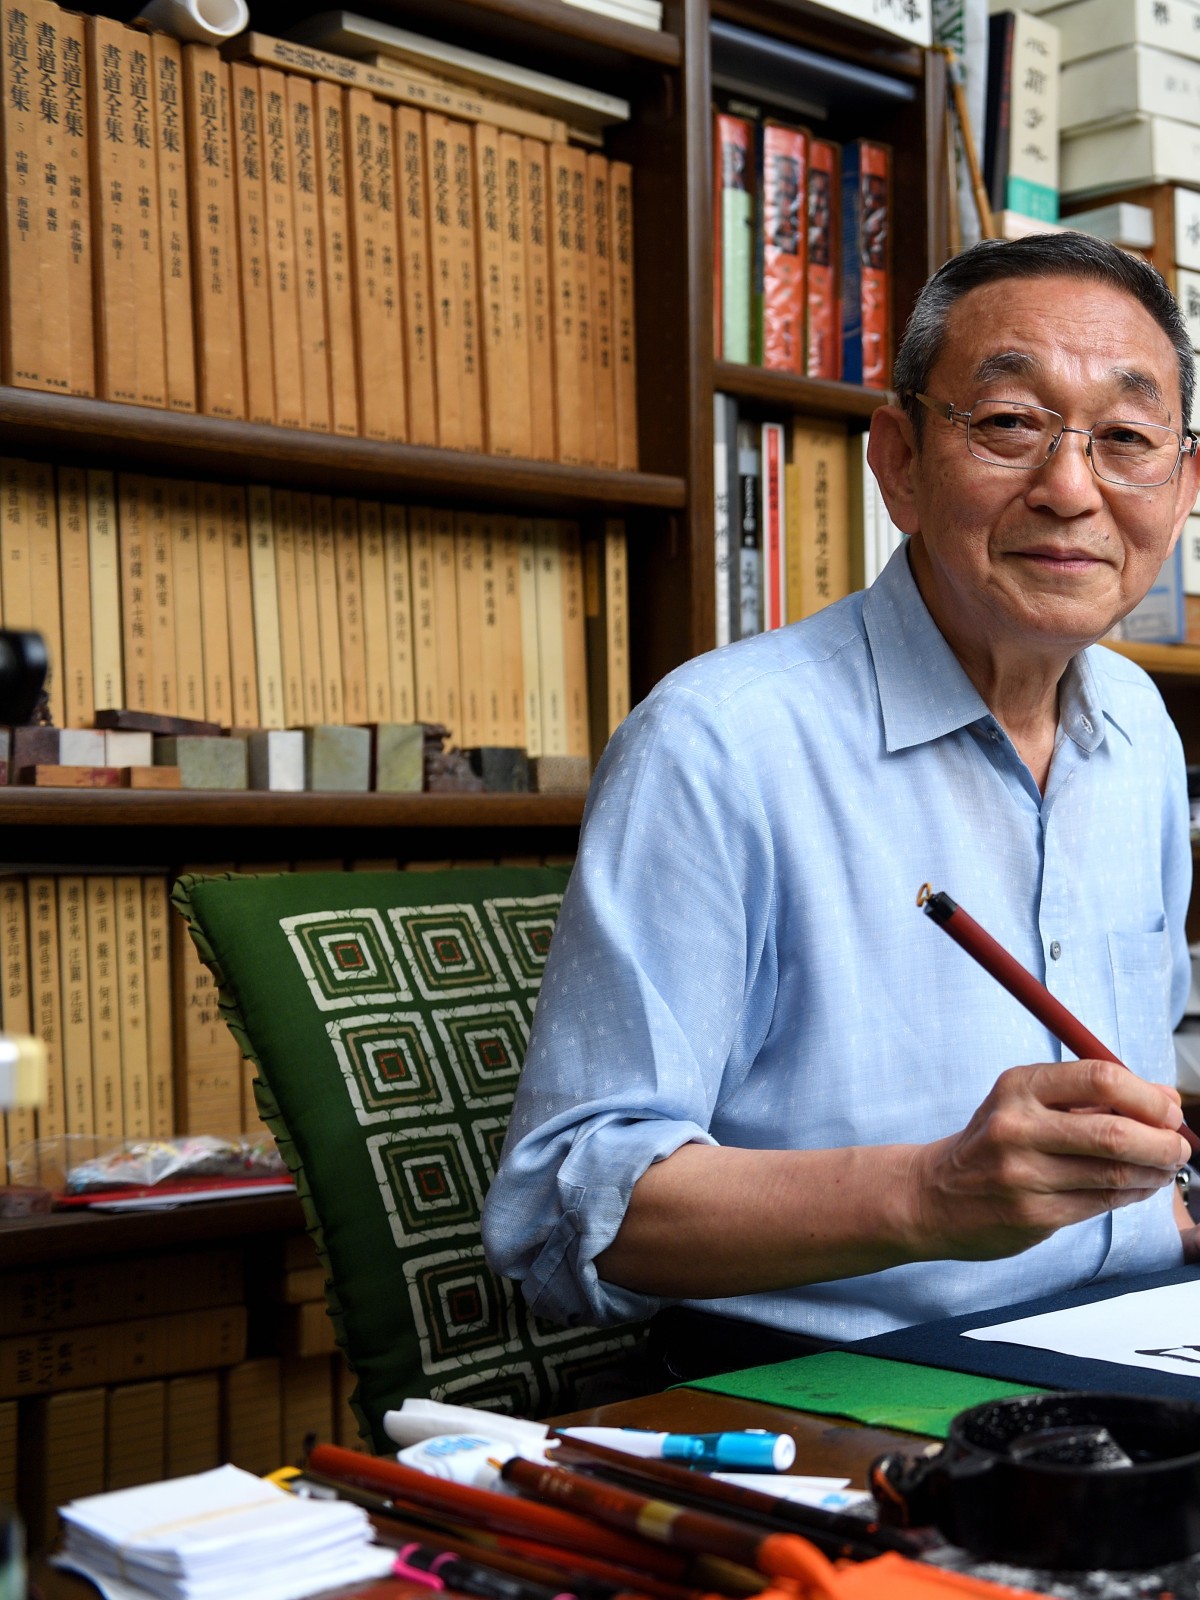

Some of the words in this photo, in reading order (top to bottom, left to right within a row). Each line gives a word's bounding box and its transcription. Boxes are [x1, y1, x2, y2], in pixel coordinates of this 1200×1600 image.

[6, 8, 31, 114] 書道全集
[35, 21, 60, 125] 書道全集
[61, 36, 85, 138] 書道全集
[102, 43, 125, 144] 書道全集
[129, 49, 152, 150] 書道全集
[159, 55, 181, 154] 書道全集
[70, 147, 79, 159] 6
[199, 69, 220, 168] 書道全集
[238, 85, 260, 181] 書道全集
[265, 90, 287, 186] 書道全集
[293, 101, 315, 195] 書道全集
[324, 105, 344, 198] 書道全集
[356, 112, 375, 205] 書道全集
[375, 122, 393, 212] 書道全集
[403, 130, 421, 220] 書道全集
[432, 138, 450, 228] 書道全集
[454, 142, 471, 230] 書道全集
[482, 145, 498, 232] 書道全集
[504, 158, 521, 244] 書道全集
[527, 160, 544, 246] 書道全集
[556, 165, 572, 249] 書道全集
[572, 170, 587, 255] 書道全集
[593, 178, 607, 260] 書道全集
[617, 183, 631, 265] 書道全集
